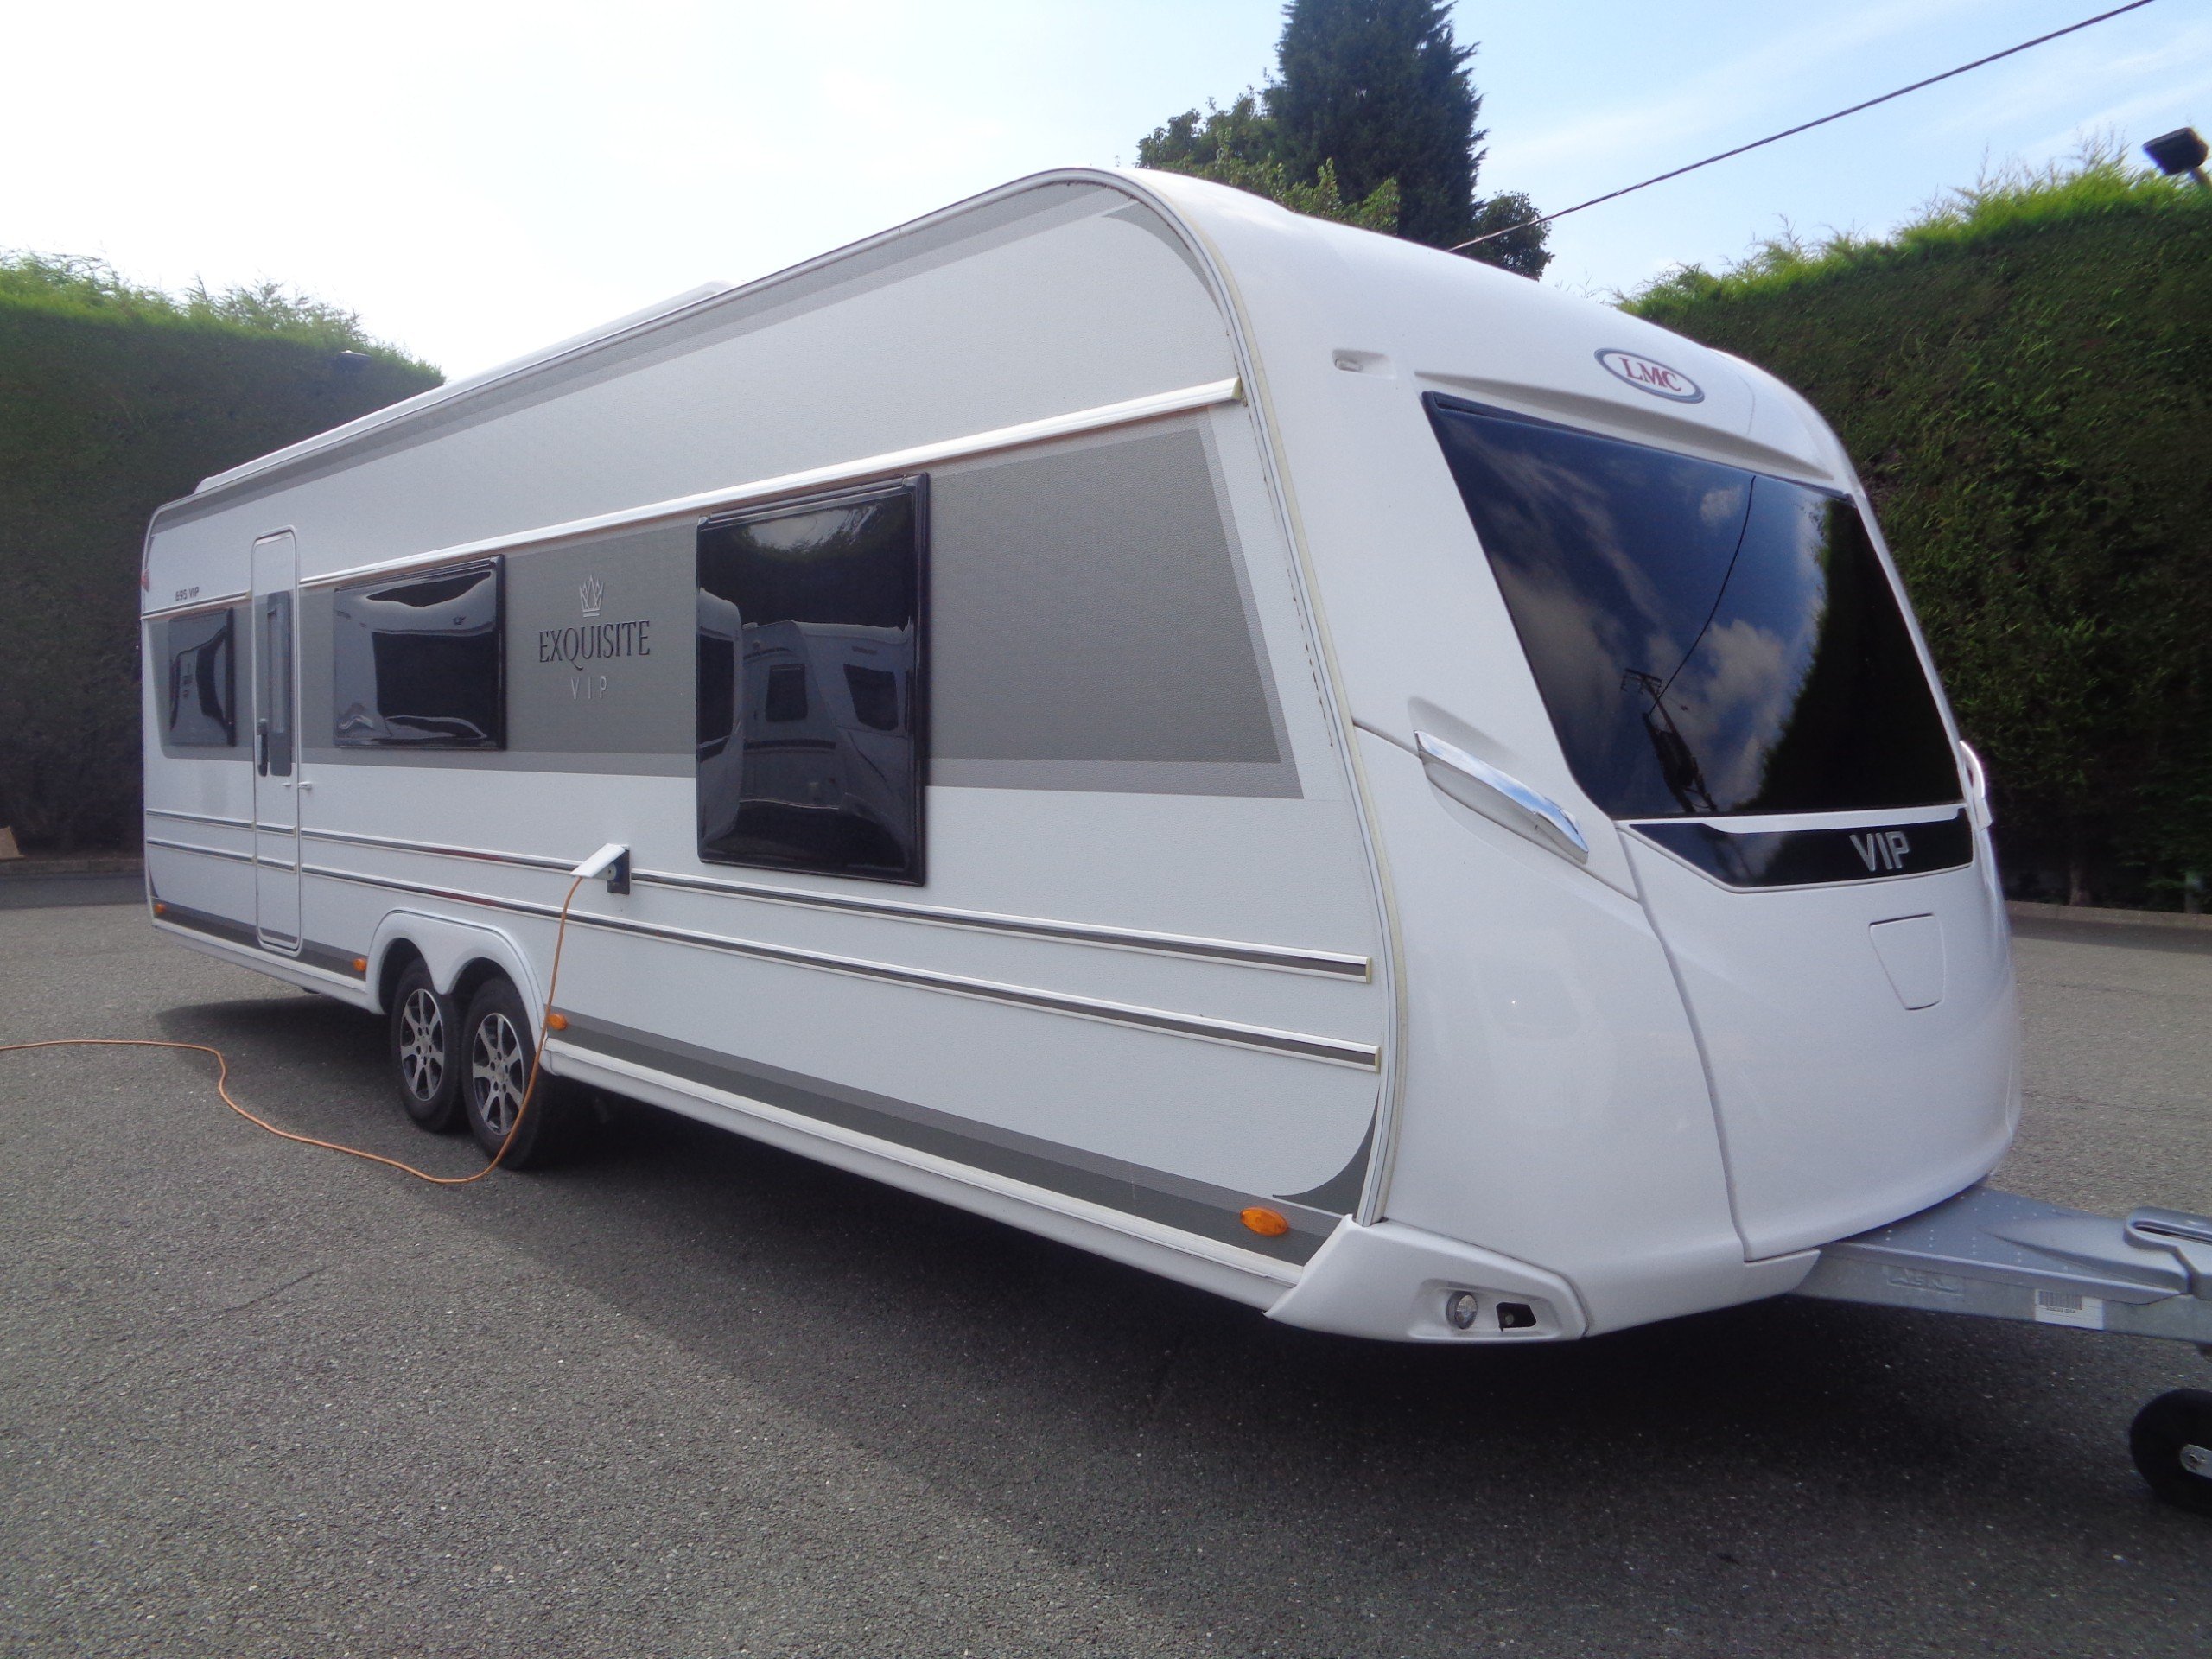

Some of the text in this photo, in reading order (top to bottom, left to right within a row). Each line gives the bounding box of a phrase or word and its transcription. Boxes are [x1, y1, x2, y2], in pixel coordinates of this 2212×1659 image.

[1618, 357, 1681, 391] LMC
[188, 587, 199, 598] VIP
[539, 620, 650, 671] EXQUISITE
[570, 676, 607, 700] VIP
[1849, 831, 1910, 872] VIP
